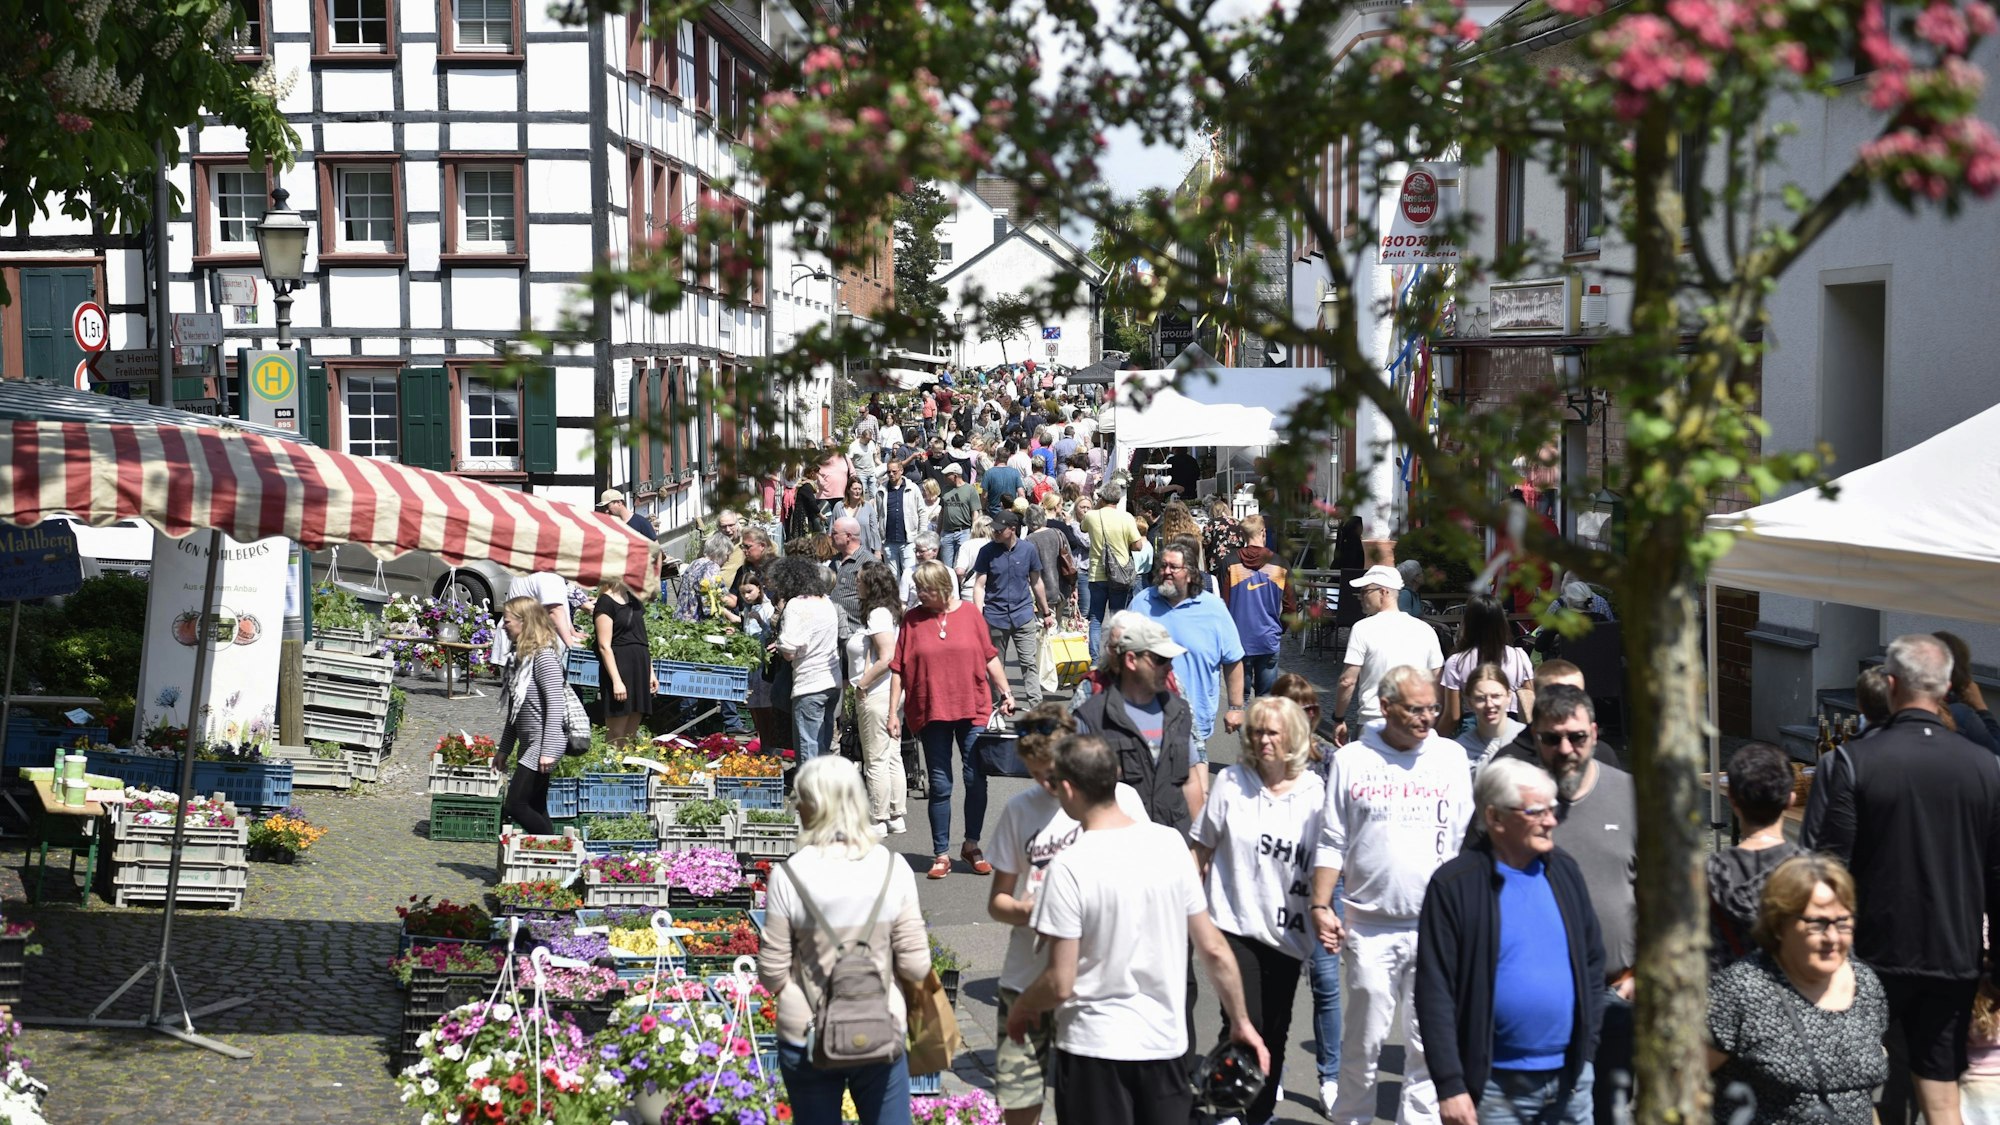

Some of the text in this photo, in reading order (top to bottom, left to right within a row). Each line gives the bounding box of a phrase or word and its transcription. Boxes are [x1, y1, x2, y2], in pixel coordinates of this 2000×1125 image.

[1382, 249, 1457, 258] Grill Pizzeria
[127, 353, 160, 363] Heimb
[115, 366, 180, 377] Freilichtmum
[277, 409, 291, 417] 808
[277, 420, 291, 428] 895
[203, 542, 270, 561] MHLBERGS
[183, 583, 198, 591] Aus
[233, 585, 258, 593] Anbau
